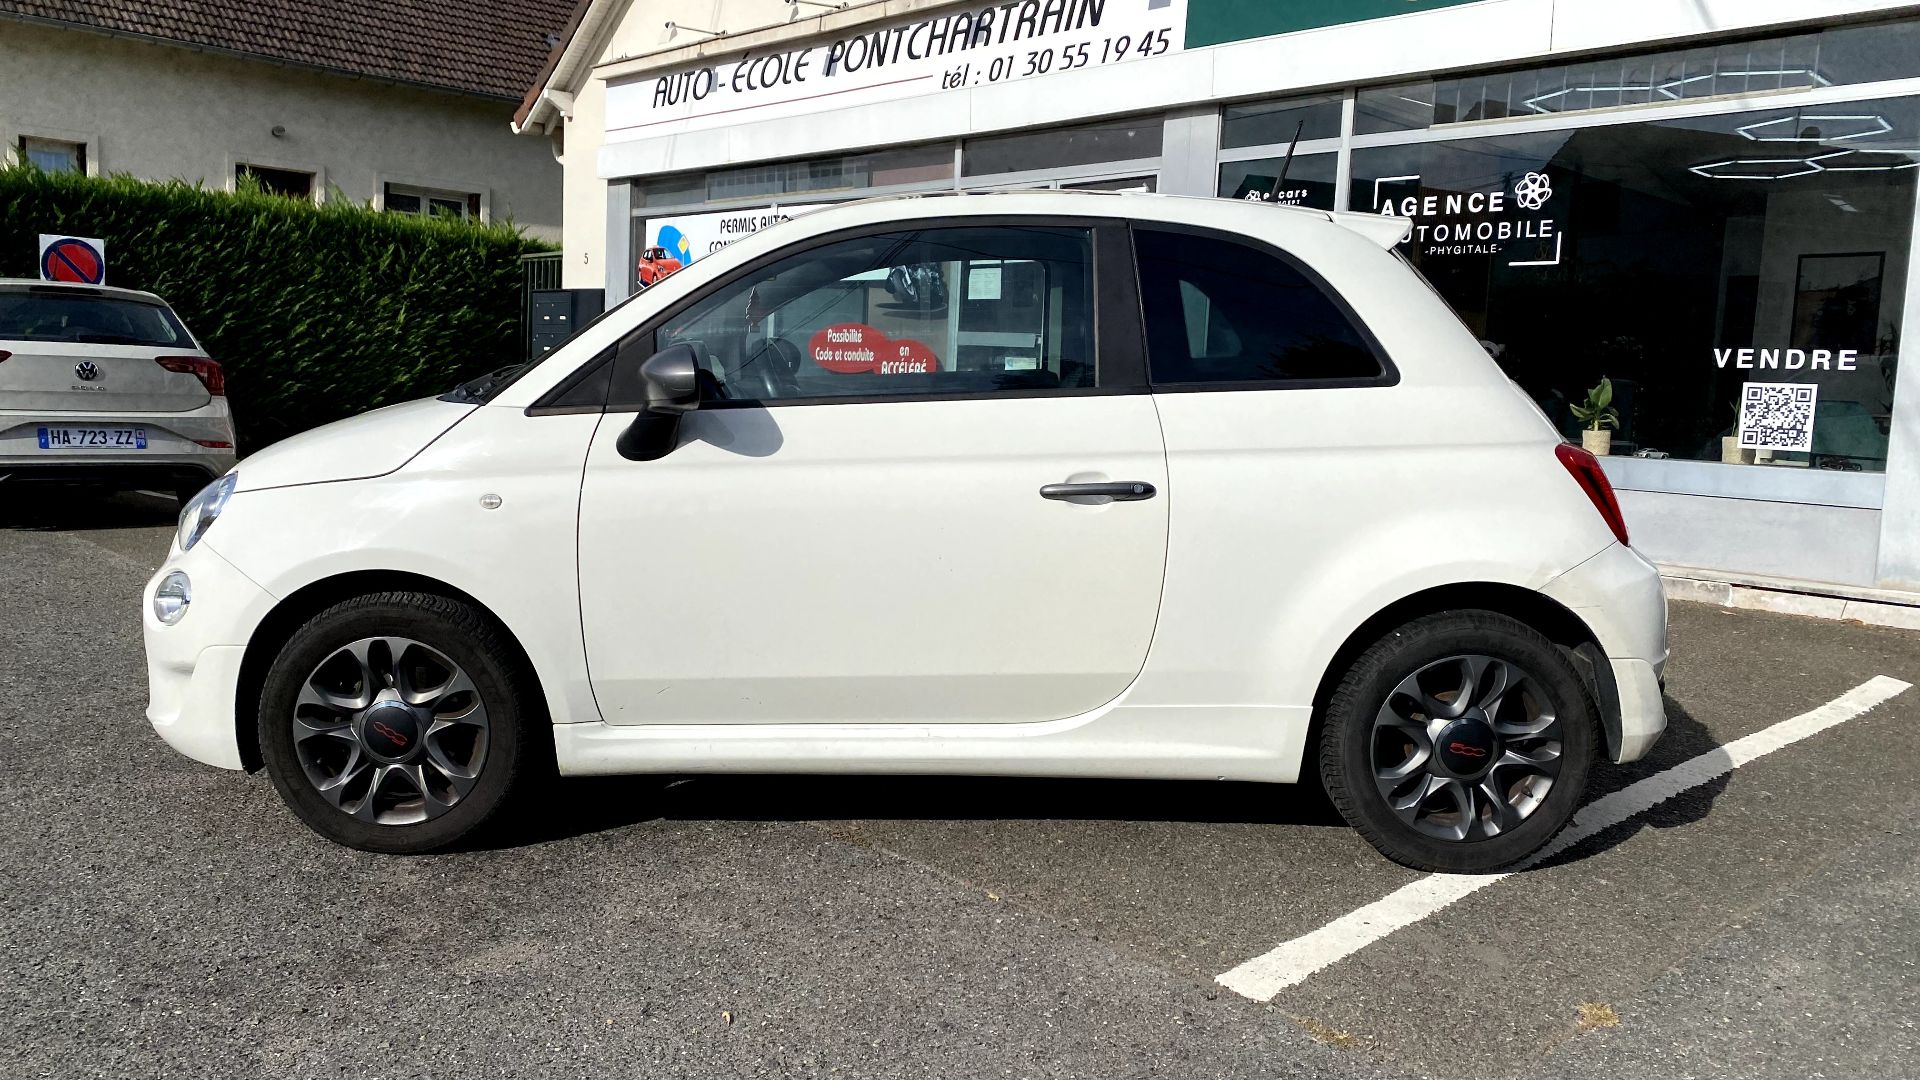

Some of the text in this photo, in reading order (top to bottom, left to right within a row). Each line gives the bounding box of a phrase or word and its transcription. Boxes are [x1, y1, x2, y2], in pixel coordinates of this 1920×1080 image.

[825, 0, 1105, 77] PONTCHARTRAIN
[989, 55, 1015, 82] 01
[1022, 48, 1054, 77] 30
[1059, 42, 1091, 71] 55
[1101, 35, 1132, 64] 19
[1137, 27, 1172, 57] 45
[1381, 191, 1504, 217] AGENCE
[720, 216, 757, 234] PERMIS
[1400, 219, 1554, 244] UTOMOBILE
[583, 252, 589, 265] 5
[827, 328, 863, 343] Possibilité
[815, 347, 875, 362] Code et conduite
[899, 346, 910, 356] en
[1713, 348, 1858, 371] VENDRE
[50, 430, 134, 445] HA-723-ZZ
